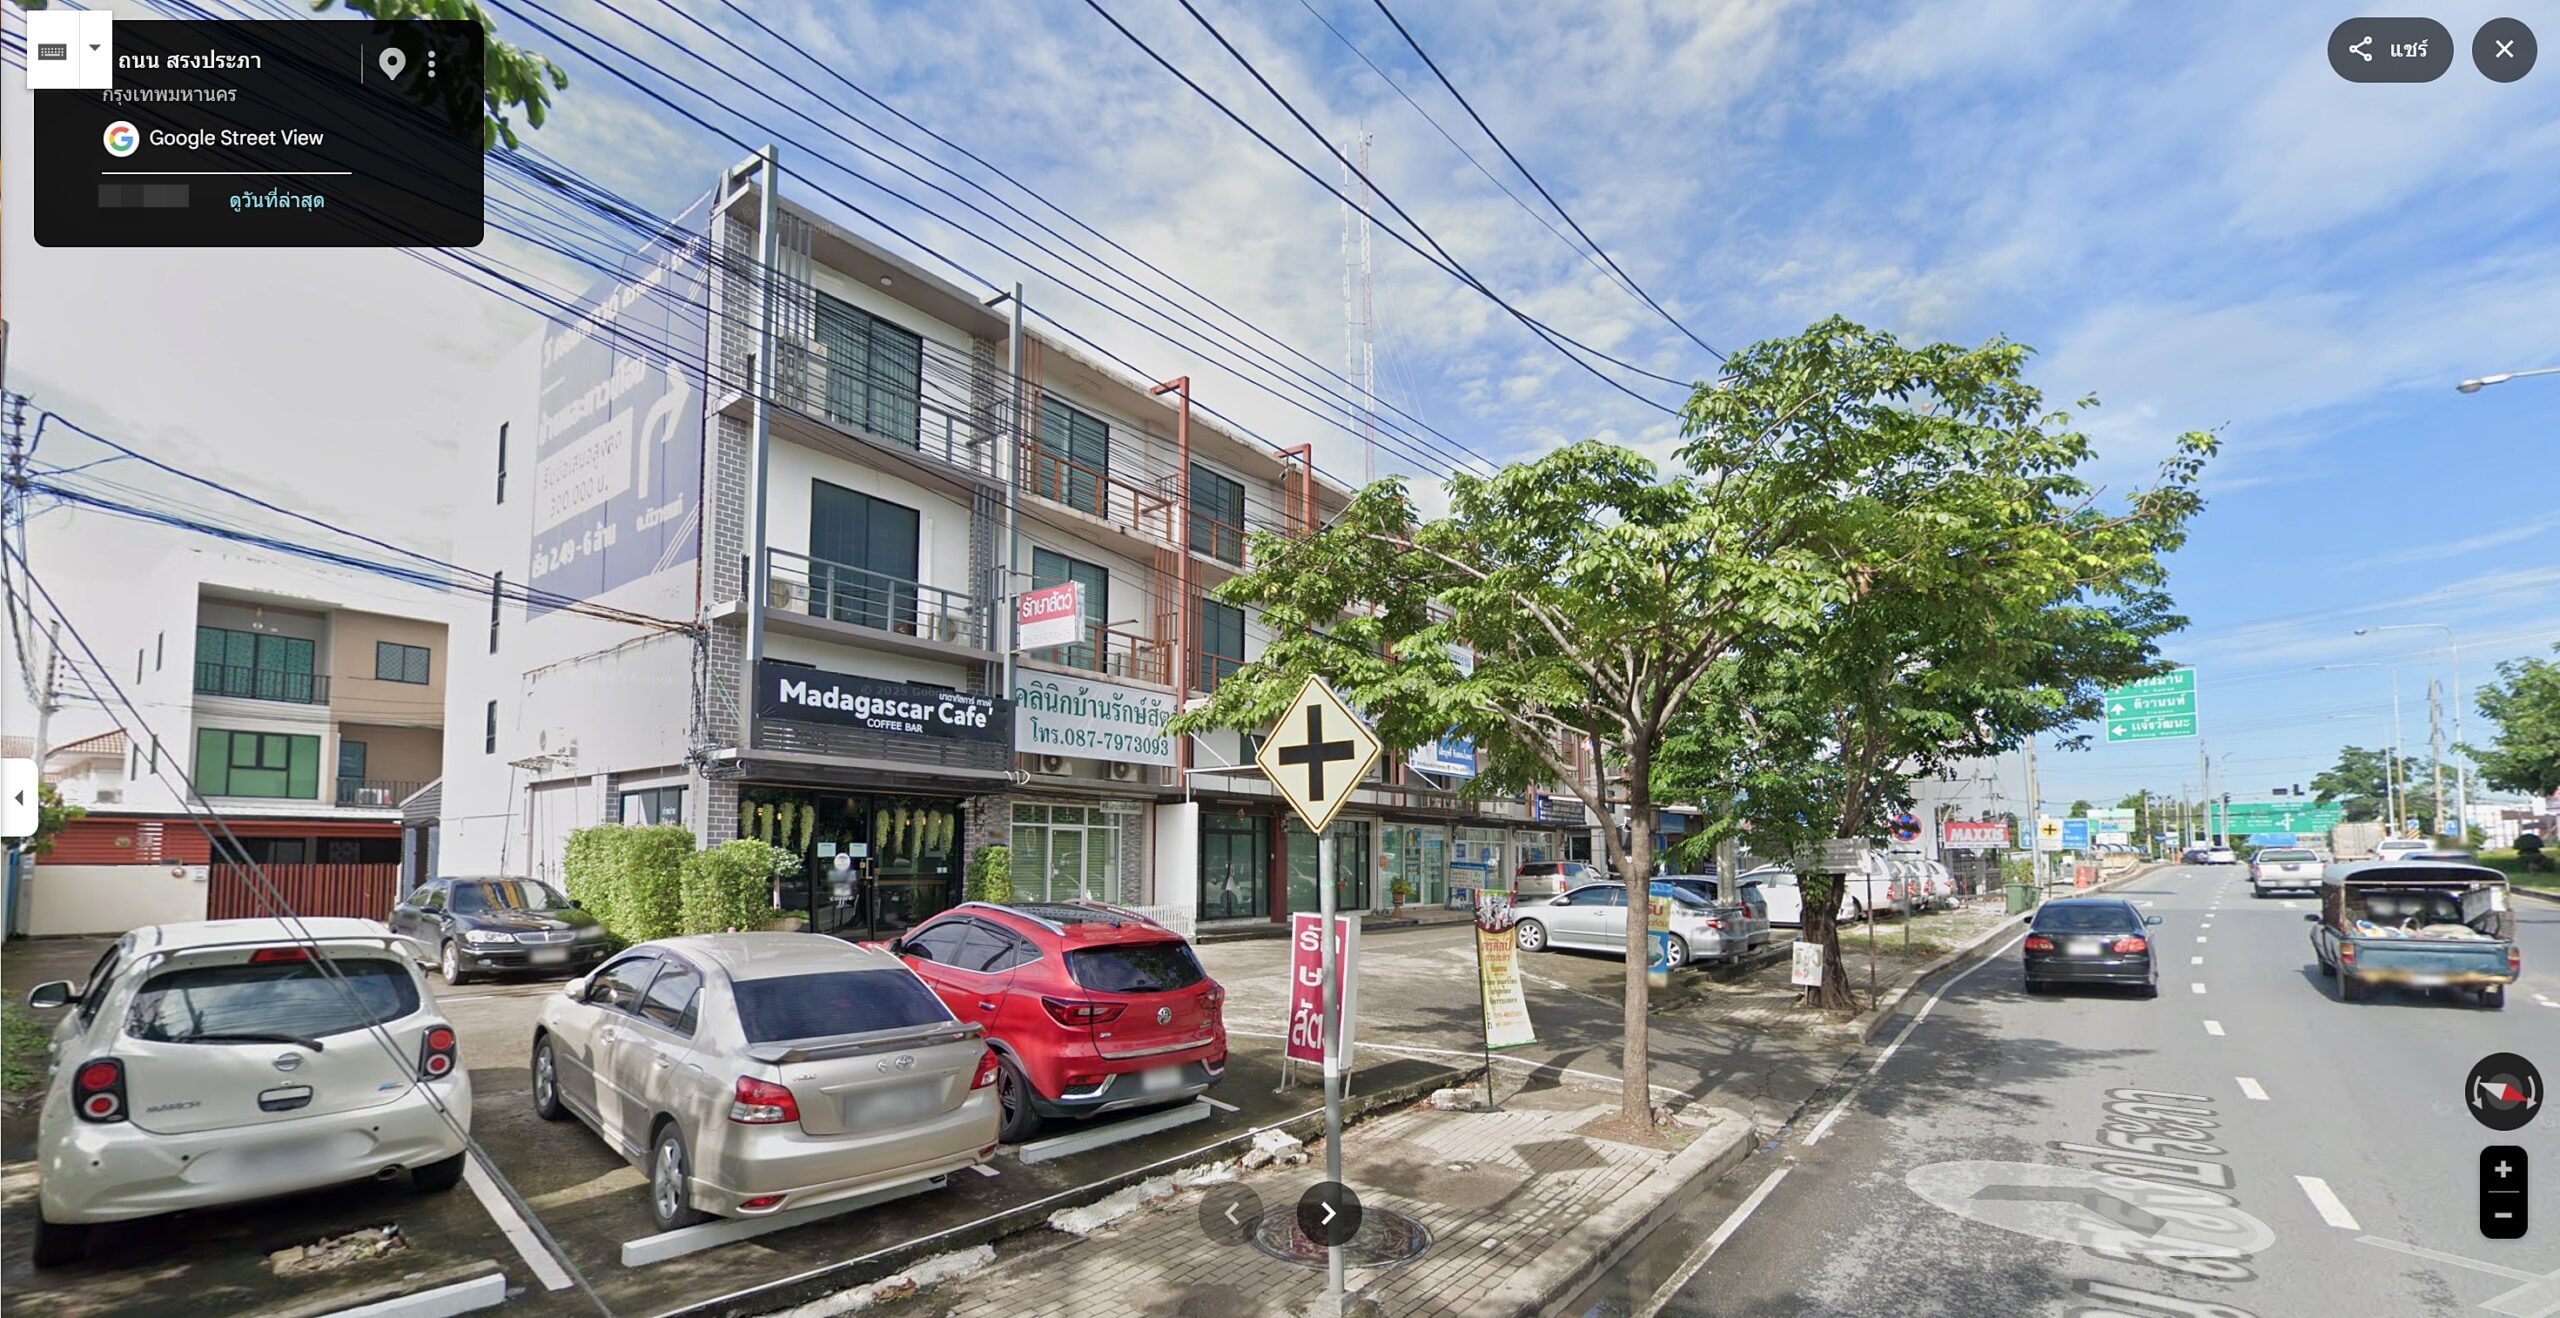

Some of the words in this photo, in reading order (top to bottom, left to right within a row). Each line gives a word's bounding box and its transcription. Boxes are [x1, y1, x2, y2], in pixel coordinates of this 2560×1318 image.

[550, 538, 575, 572] 2.49
[583, 530, 592, 556] 6
[594, 520, 617, 552] ล้าน
[1022, 588, 1073, 618] รักษาสัตว์
[779, 678, 935, 721] Madagascar
[1015, 680, 1178, 728] คลินิกบ้านรักษ์สัต
[2133, 692, 2186, 709] ติวานนท์
[867, 718, 902, 732] COFFEE
[905, 721, 924, 734] BAR
[1030, 716, 1169, 757] โทร.087-7973093
[2131, 716, 2191, 731] แจ้งวัฒนะ
[1950, 828, 2005, 842] MAXXIS
